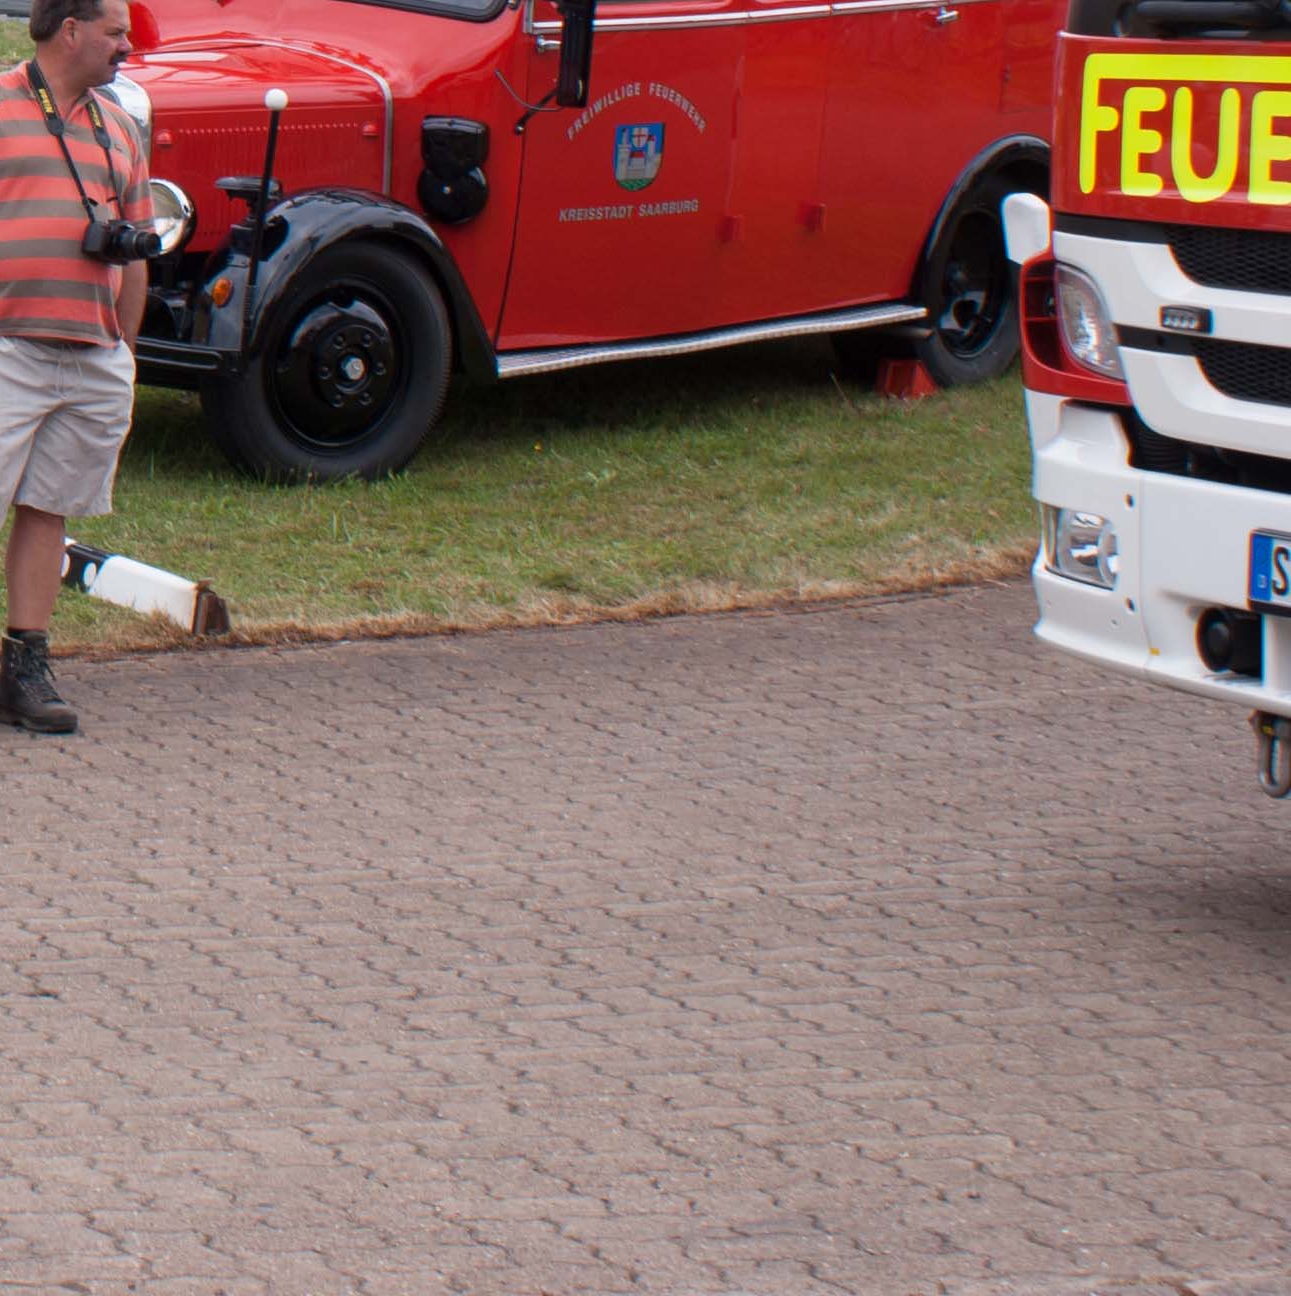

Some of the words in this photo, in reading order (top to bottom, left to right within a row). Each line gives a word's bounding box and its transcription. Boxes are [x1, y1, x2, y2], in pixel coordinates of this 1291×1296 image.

[567, 81, 642, 141] FREIWILLIGE
[648, 82, 707, 134] FEUERWEHR
[558, 205, 635, 223] KREISSTADT
[638, 199, 700, 217] SAARBURG
[1271, 545, 1291, 596] S
